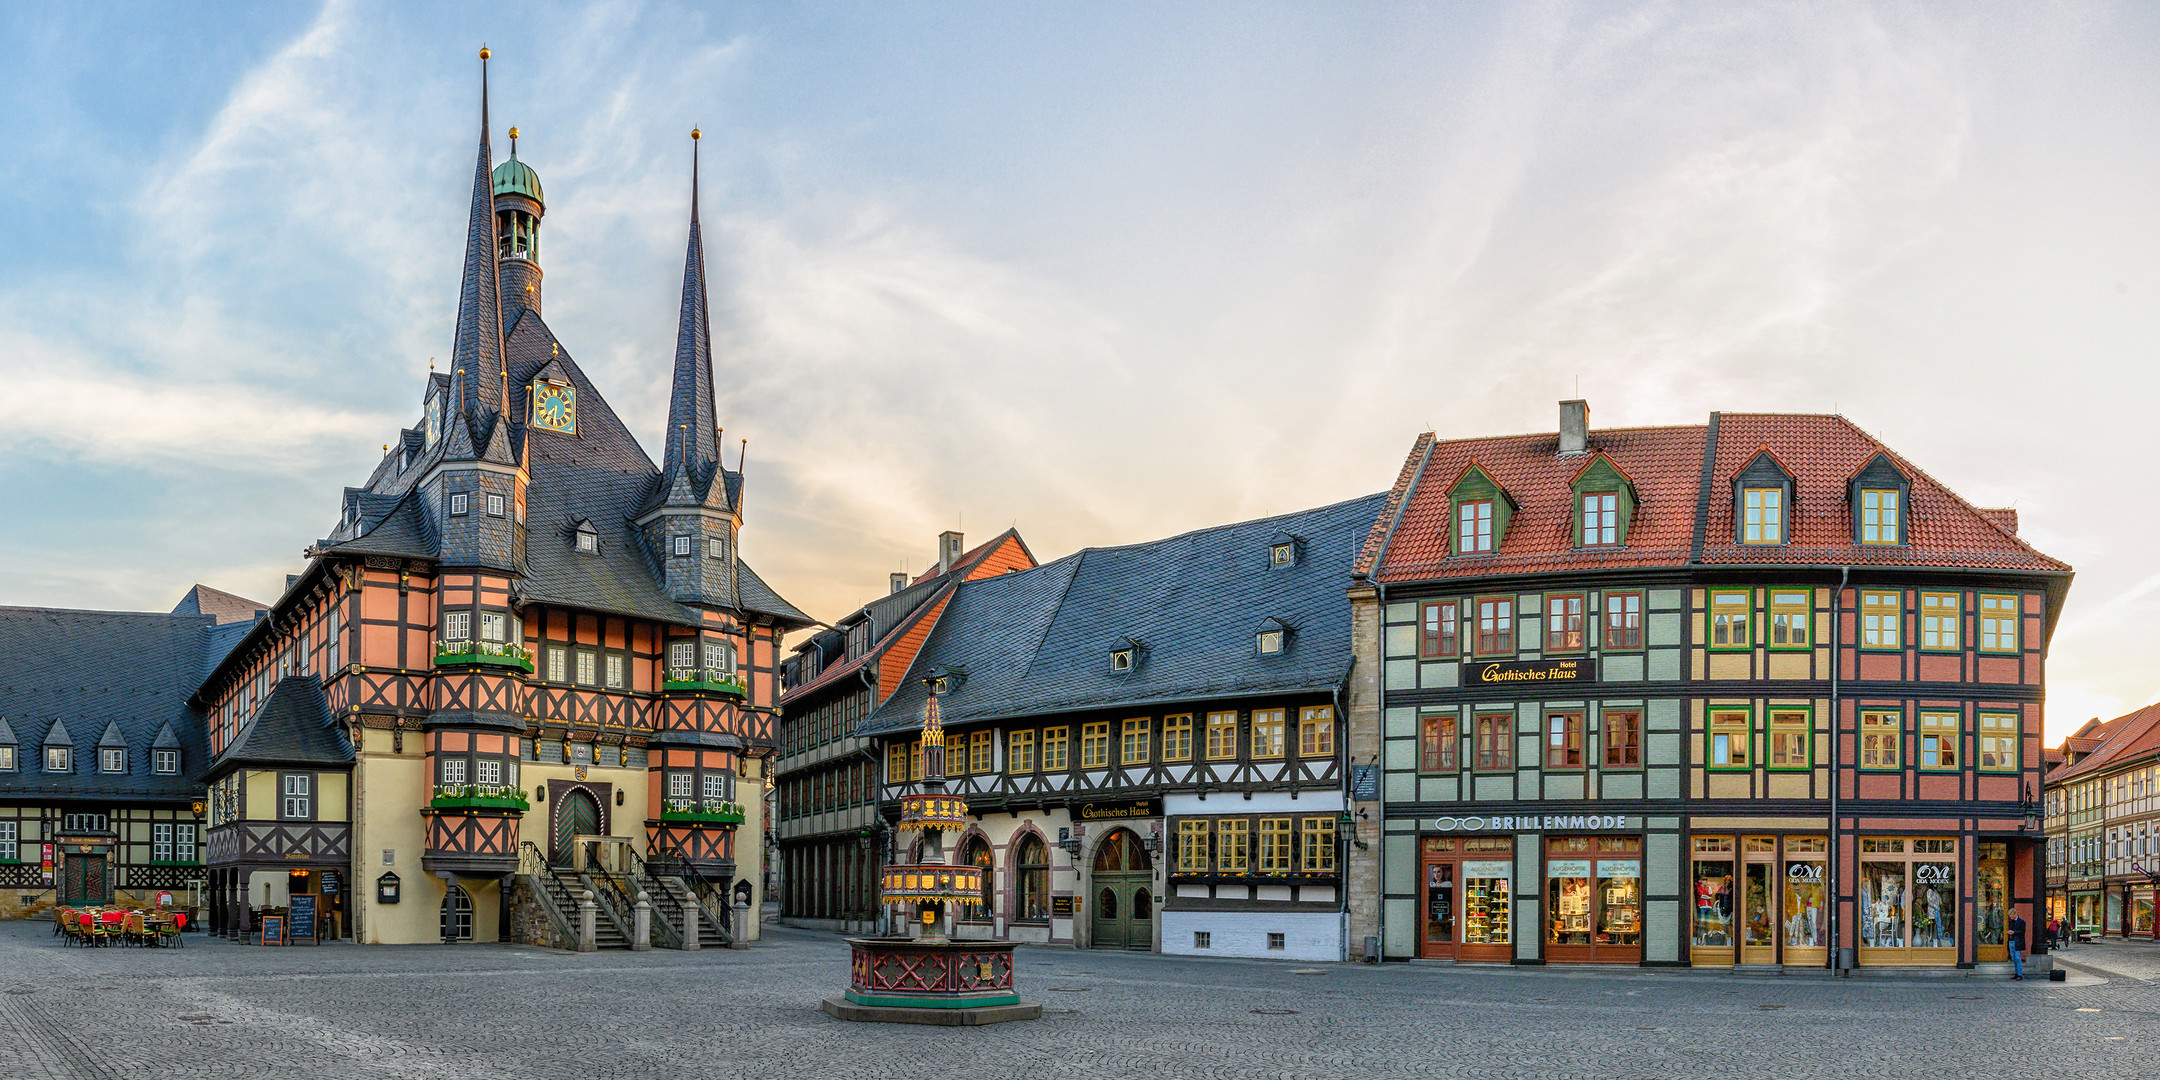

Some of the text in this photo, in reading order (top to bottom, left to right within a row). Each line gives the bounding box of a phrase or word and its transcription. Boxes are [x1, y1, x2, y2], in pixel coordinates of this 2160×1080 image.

[1482, 663, 1577, 683] Gothisches Haus
[1082, 803, 1150, 818] Gothisches Haus
[1491, 815, 1626, 830] BRILLENMODE
[1789, 864, 1823, 878] OM
[1916, 864, 1950, 878] OM
